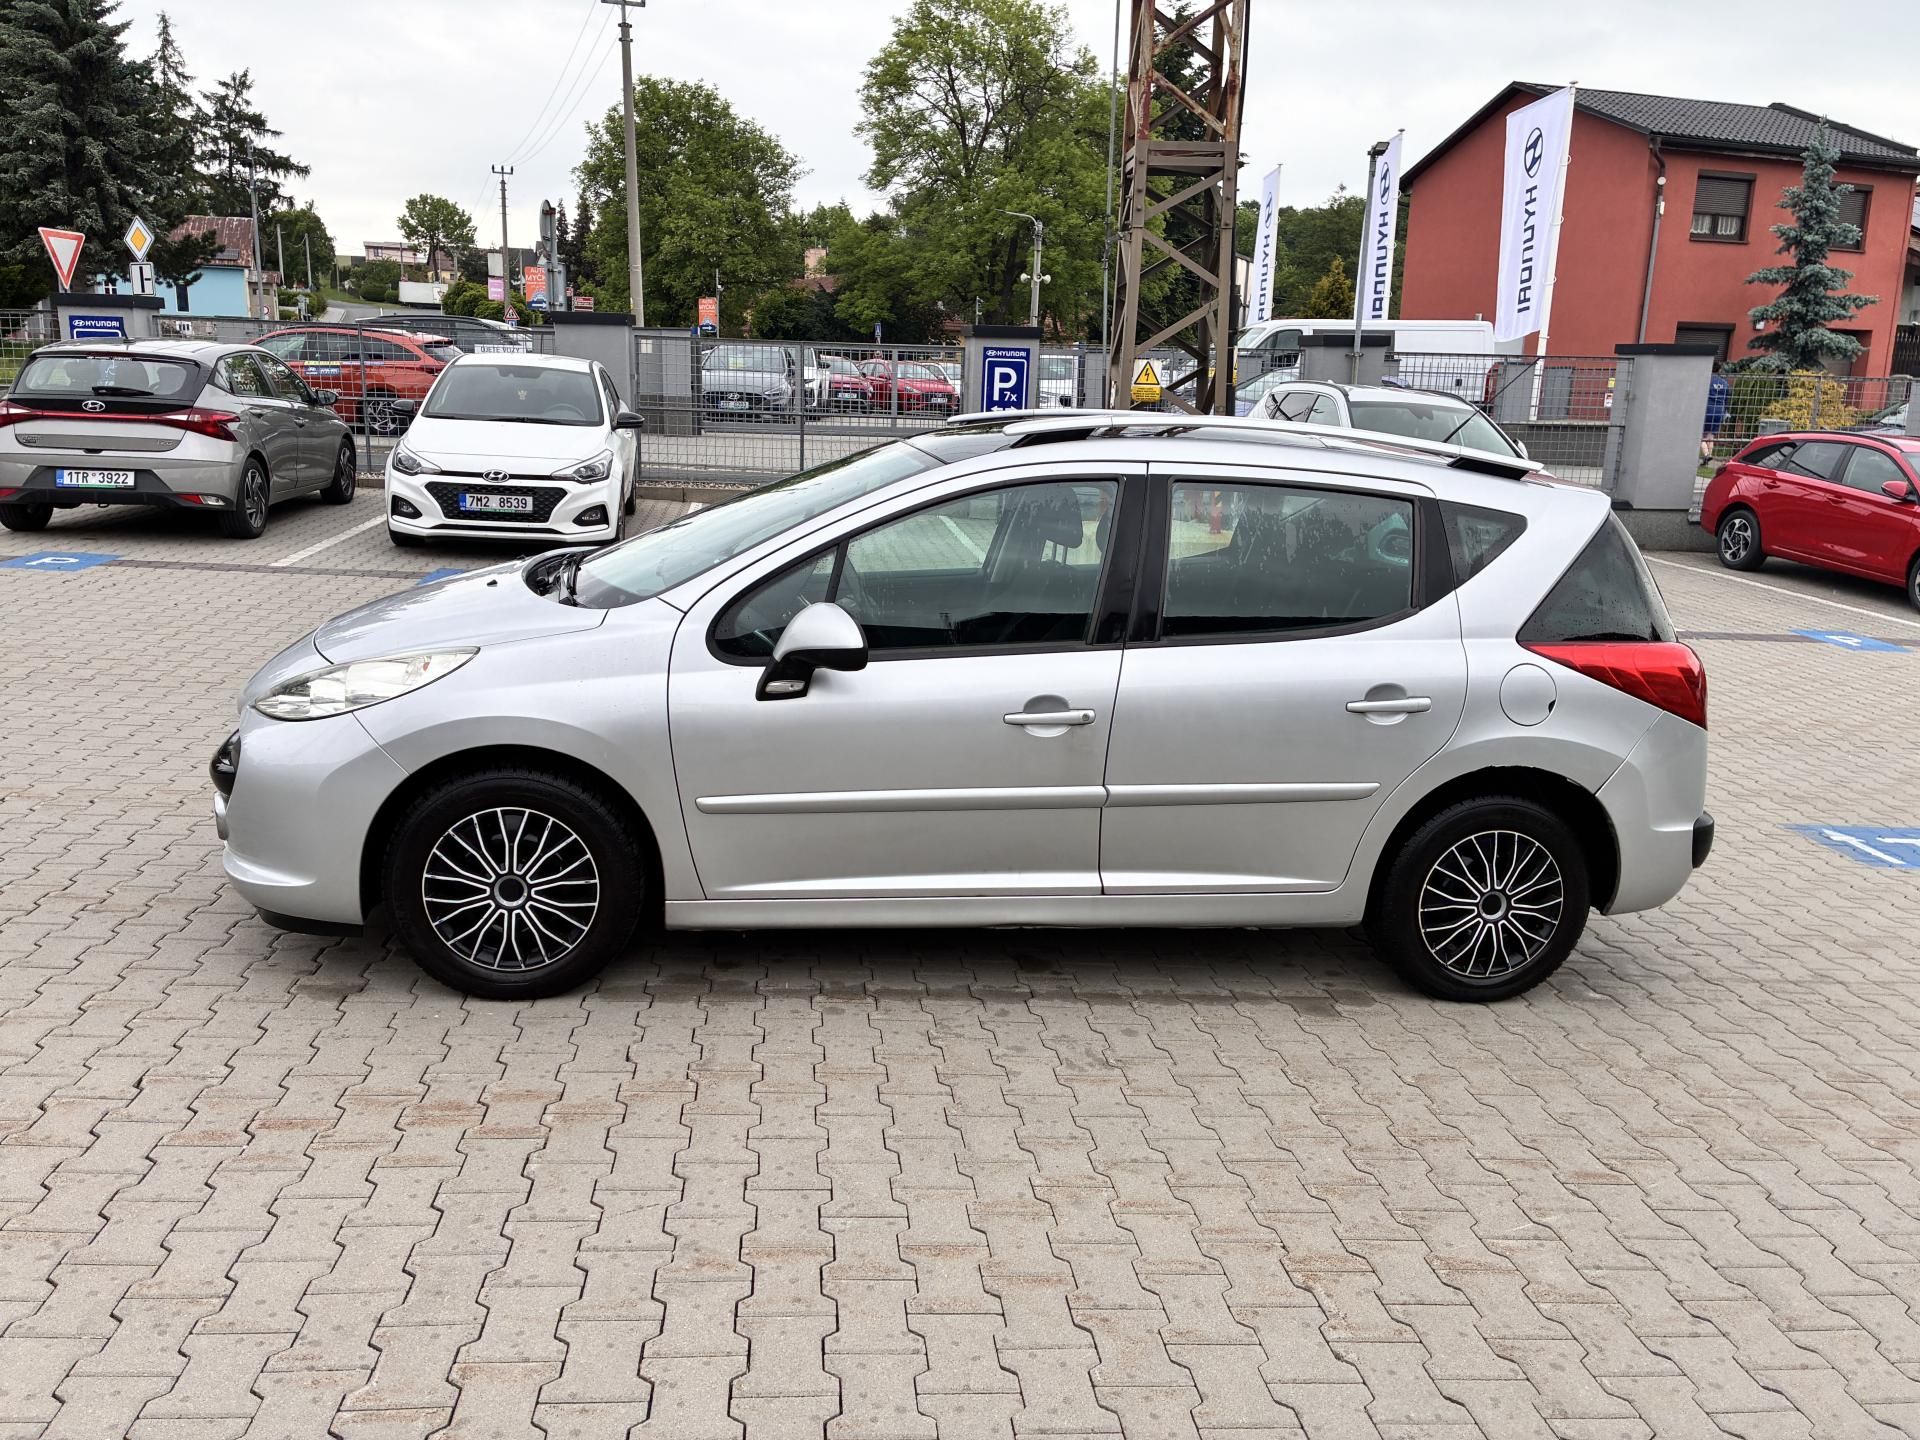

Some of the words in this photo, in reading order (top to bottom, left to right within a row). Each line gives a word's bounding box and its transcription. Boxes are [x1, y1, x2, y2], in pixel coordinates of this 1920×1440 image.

[1516, 184, 1538, 314] HYUNDAI
[1258, 234, 1271, 321] HYUNDA
[85, 320, 120, 328] HYUNDAI
[993, 367, 1018, 401] P
[1003, 391, 1018, 402] 7x
[67, 471, 90, 484] 1TR
[98, 472, 129, 485] 3922
[468, 495, 490, 508] 7M2
[498, 496, 528, 509] 8539
